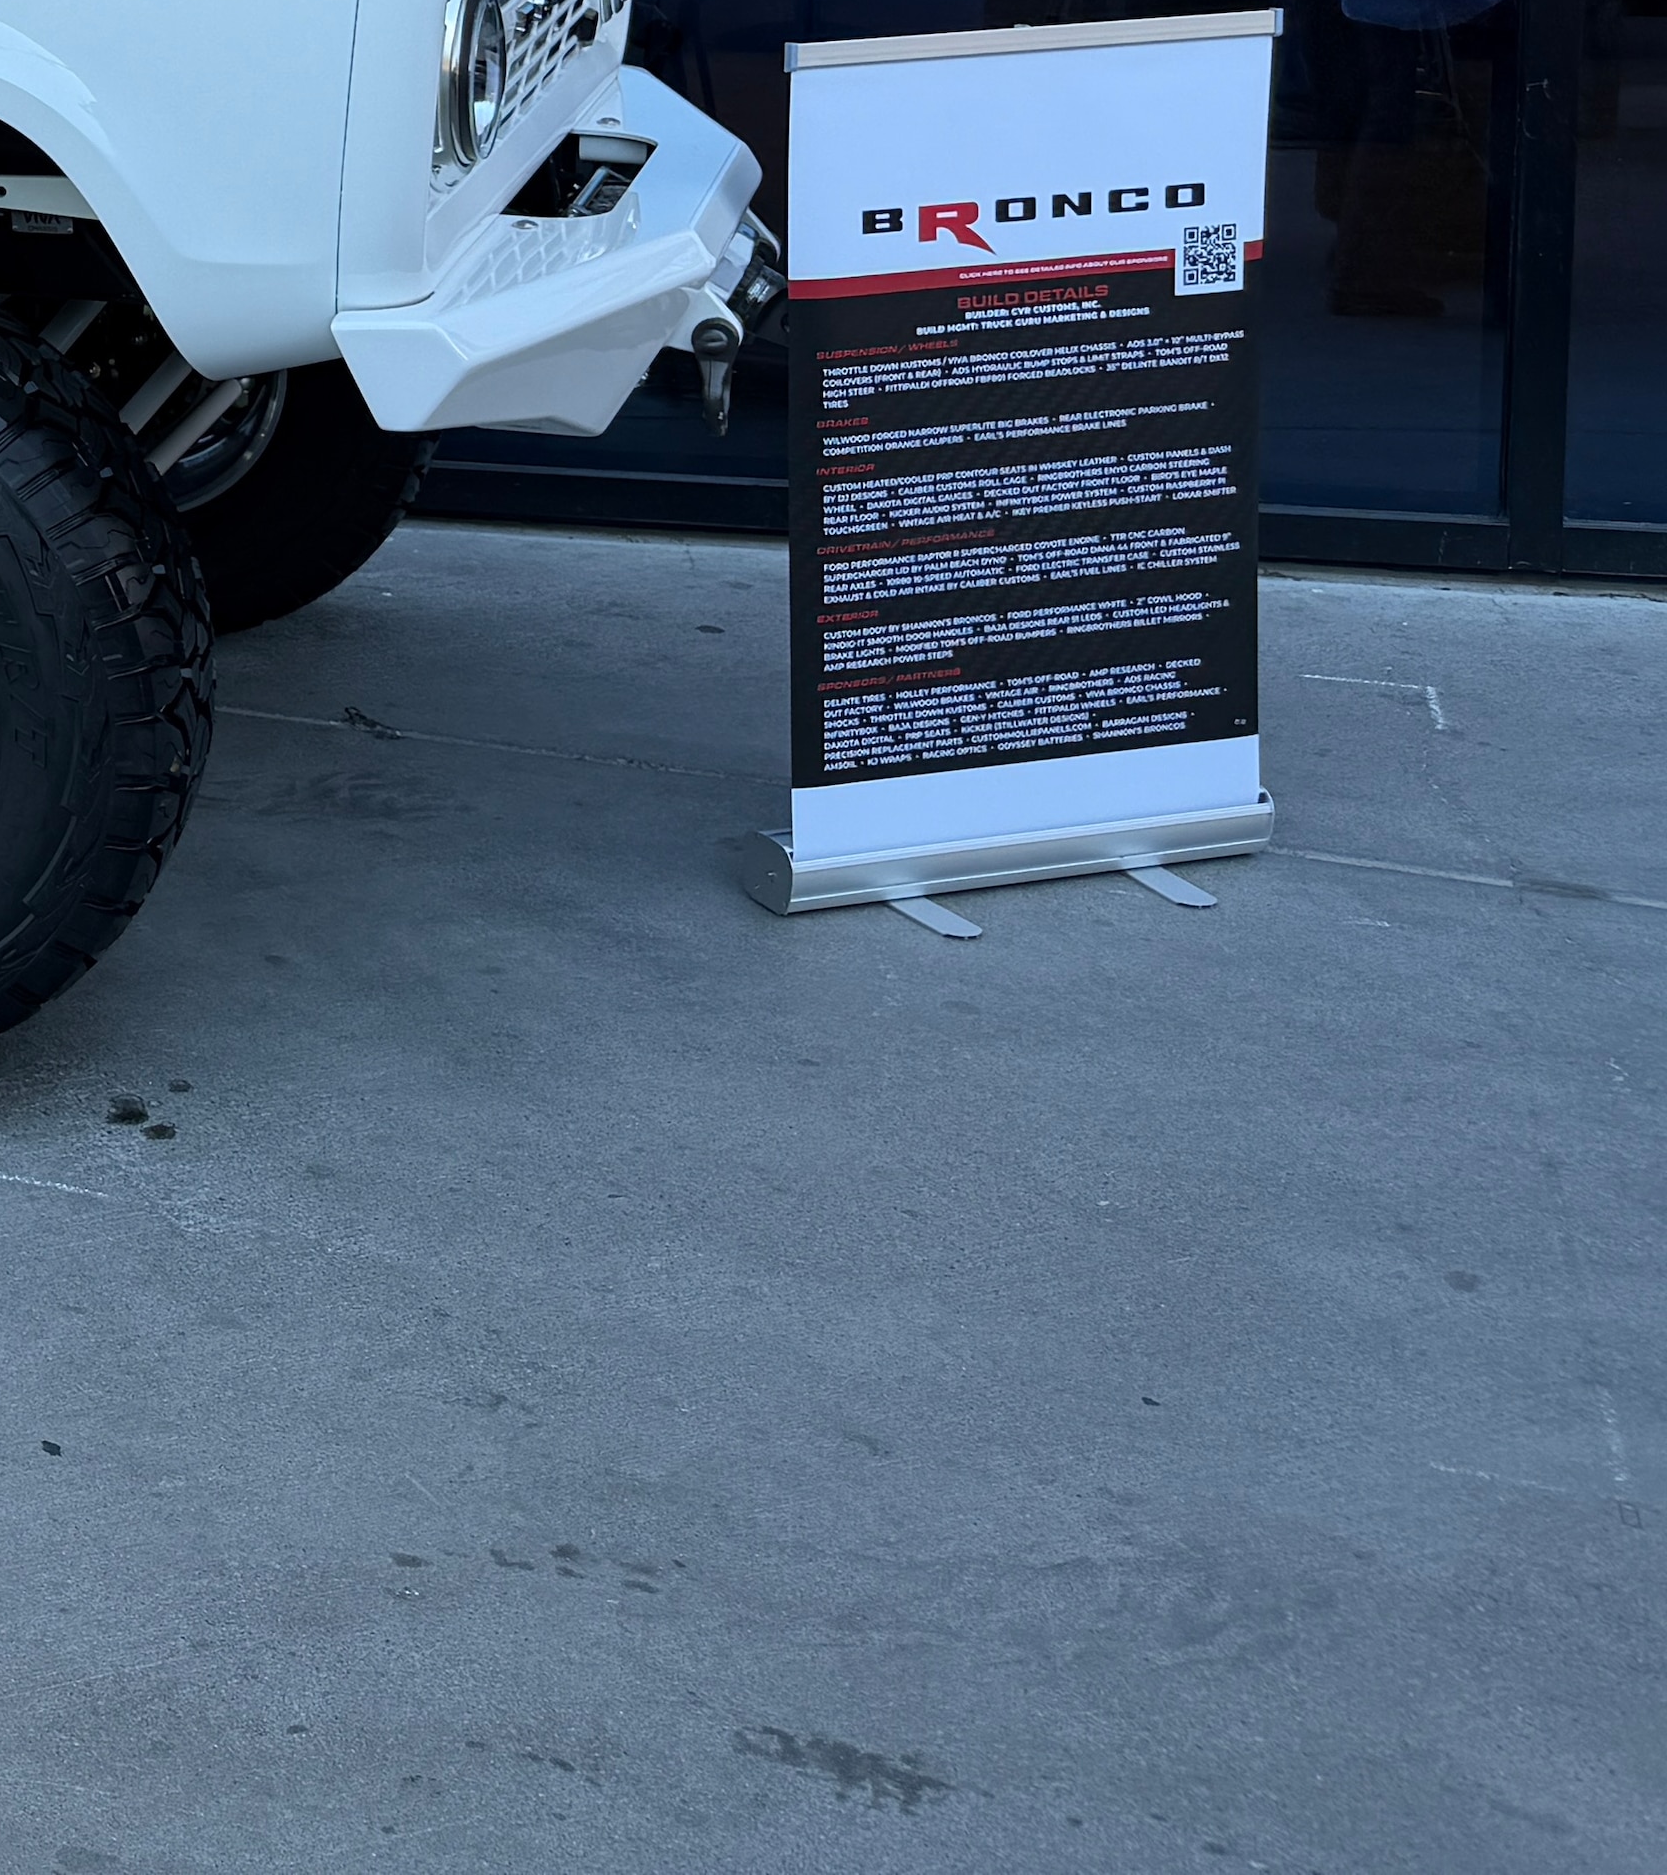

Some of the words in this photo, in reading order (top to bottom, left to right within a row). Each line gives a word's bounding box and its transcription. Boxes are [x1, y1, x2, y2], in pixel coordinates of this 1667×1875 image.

[861, 182, 1207, 256] BRONCO
[957, 292, 1019, 309] BUILD
[1024, 284, 1108, 303] DETAILS
